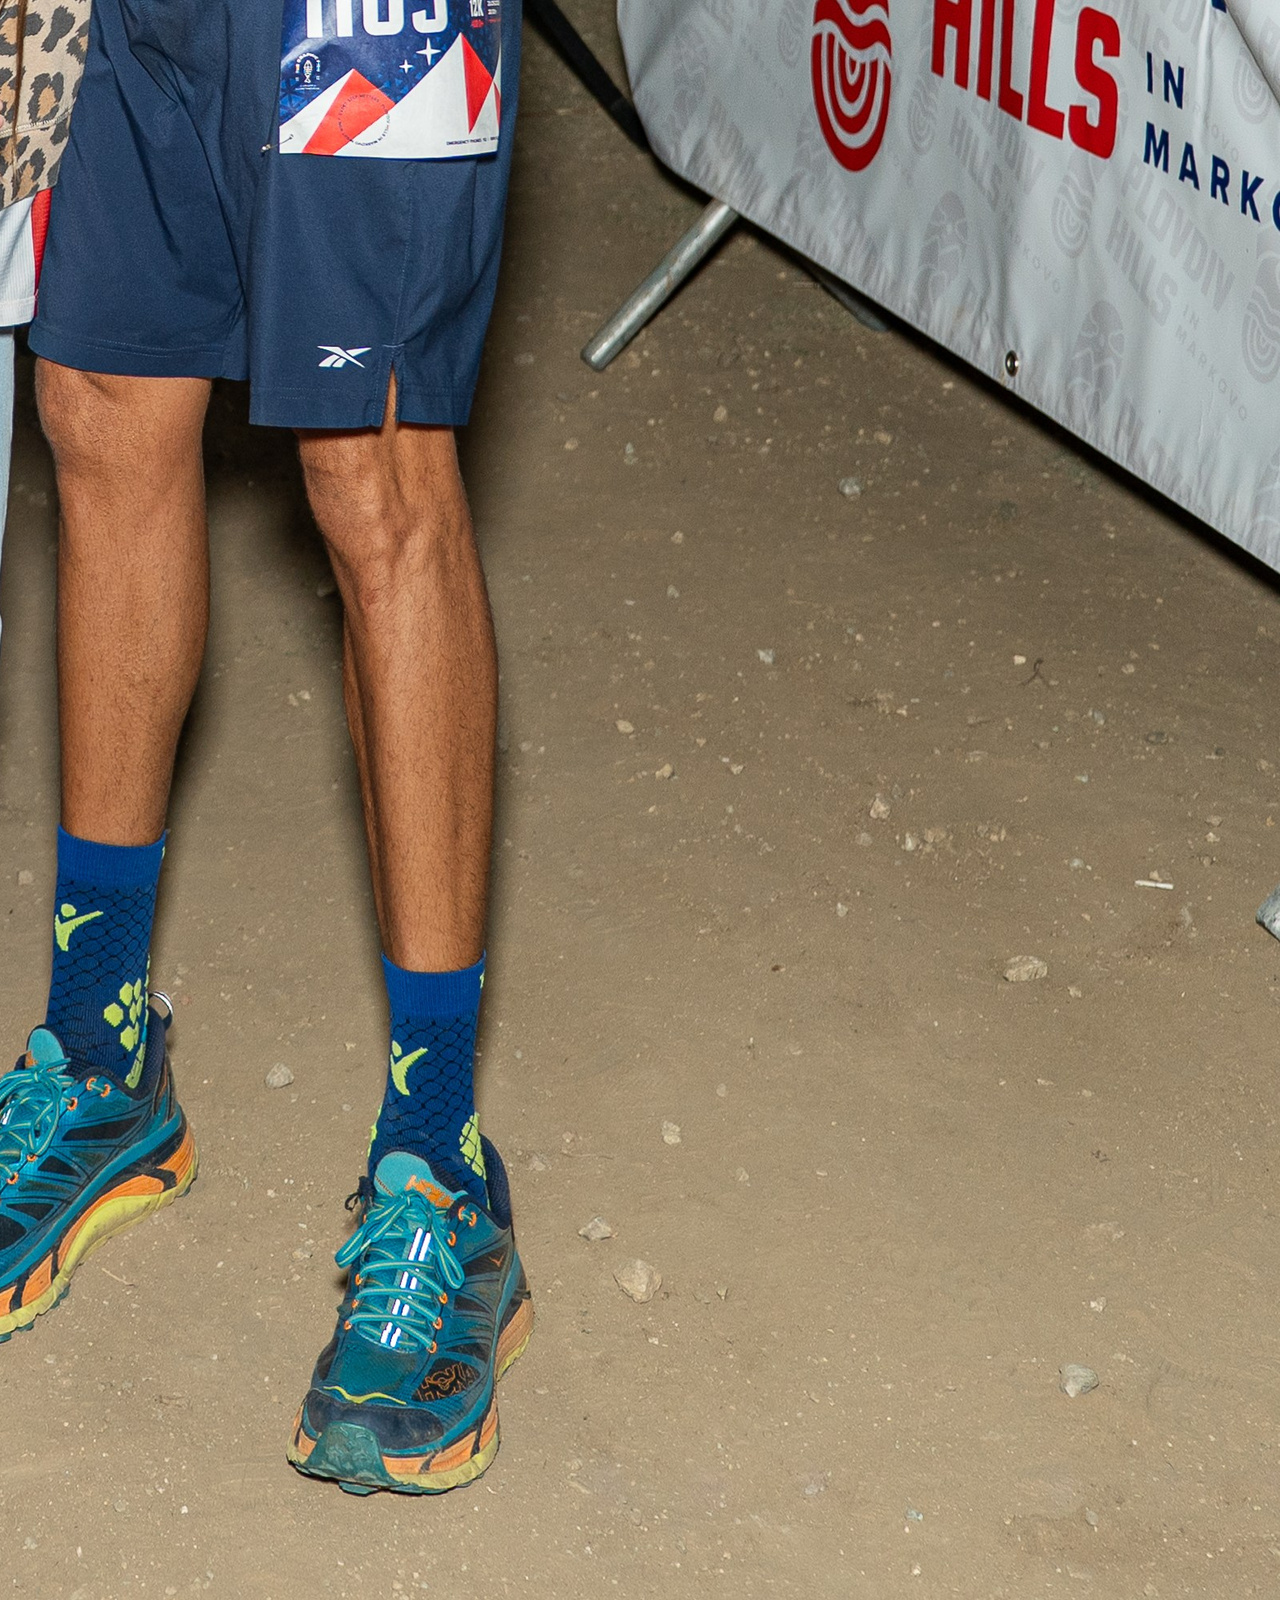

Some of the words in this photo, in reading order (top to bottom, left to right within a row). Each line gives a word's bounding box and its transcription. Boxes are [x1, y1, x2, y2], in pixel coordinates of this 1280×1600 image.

[1146, 50, 1185, 111] IN
[1105, 206, 1178, 327] HILLS
[1122, 152, 1236, 313] PLOVDIV
